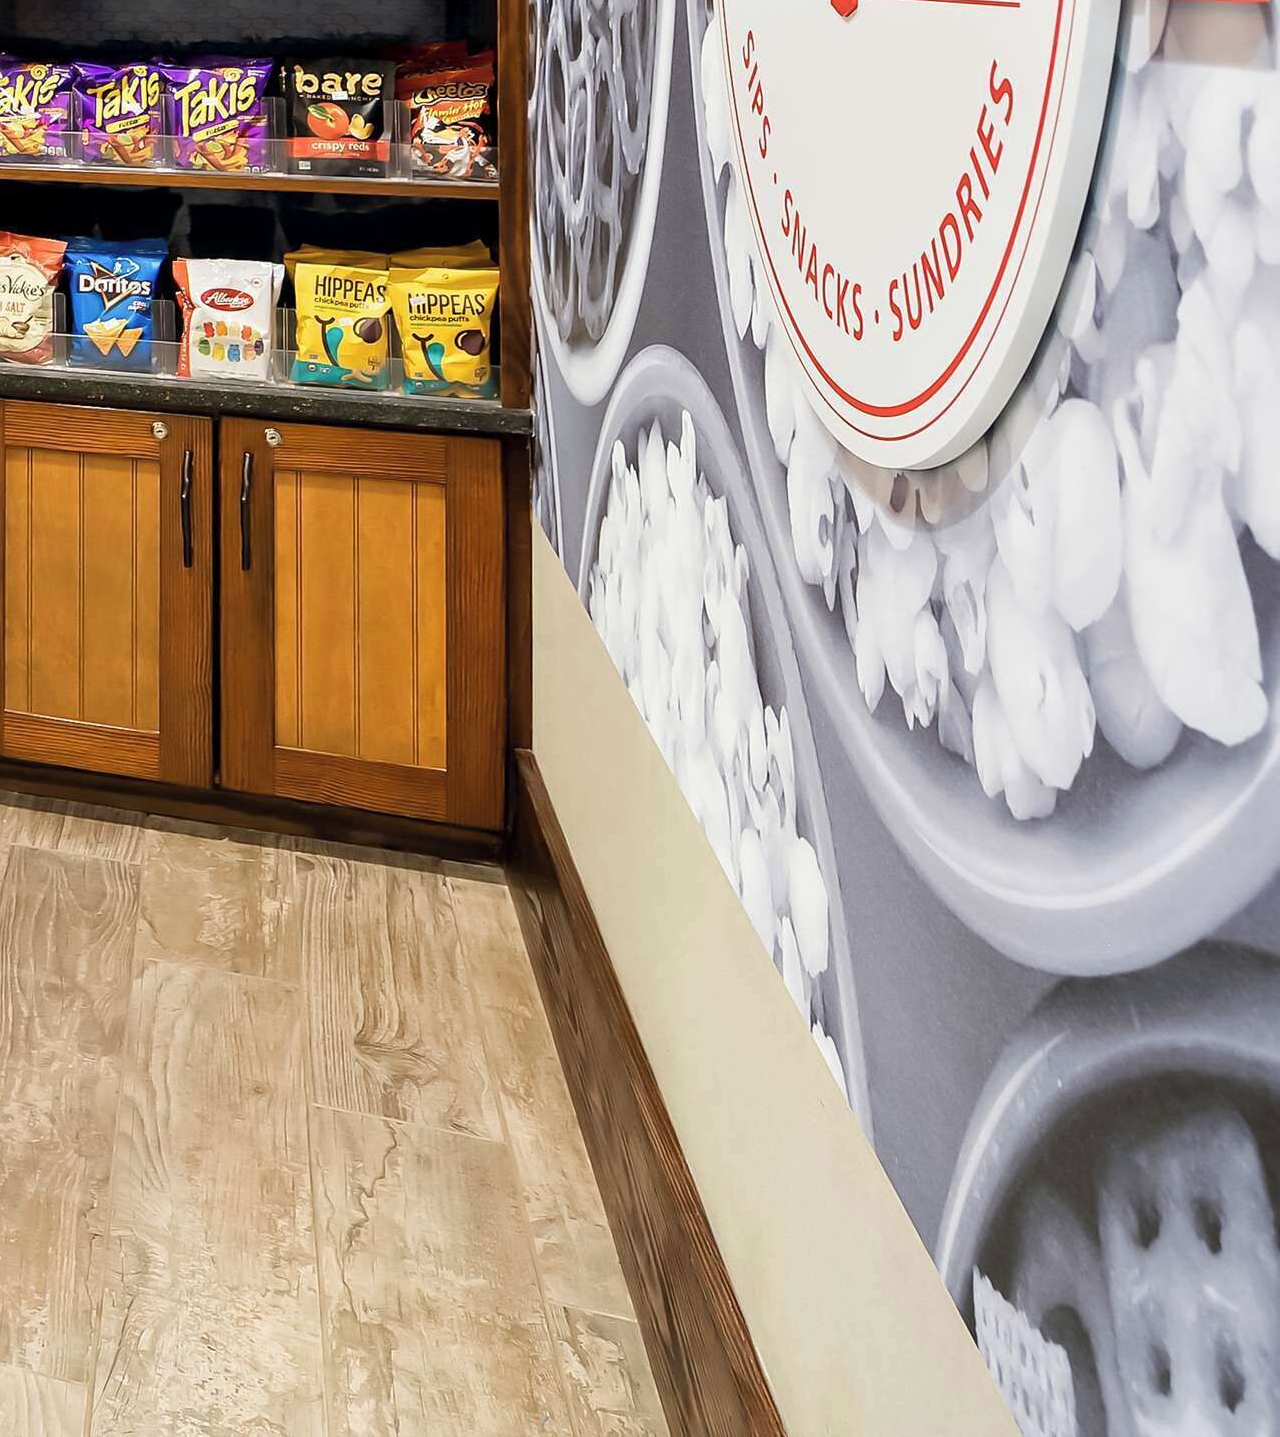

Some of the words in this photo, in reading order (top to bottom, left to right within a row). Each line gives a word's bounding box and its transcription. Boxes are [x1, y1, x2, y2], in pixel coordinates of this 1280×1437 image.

[293, 64, 384, 96] bare
[87, 65, 160, 128] Takis
[174, 68, 257, 138] Takis
[311, 141, 346, 153] crispy
[347, 139, 370, 152] reds
[742, 30, 772, 159] SIPS
[781, 189, 864, 341] SNACKS
[889, 59, 1014, 342] SUNDRIES
[6, 273, 47, 302] Vickie's
[77, 273, 152, 296] Doritos
[314, 274, 387, 304] HIPPEAS
[5, 301, 26, 313] SALT
[205, 290, 251, 308] Albanese
[313, 296, 351, 308] chickpea
[408, 314, 453, 324] chickpea
[454, 314, 471, 324] puffs
